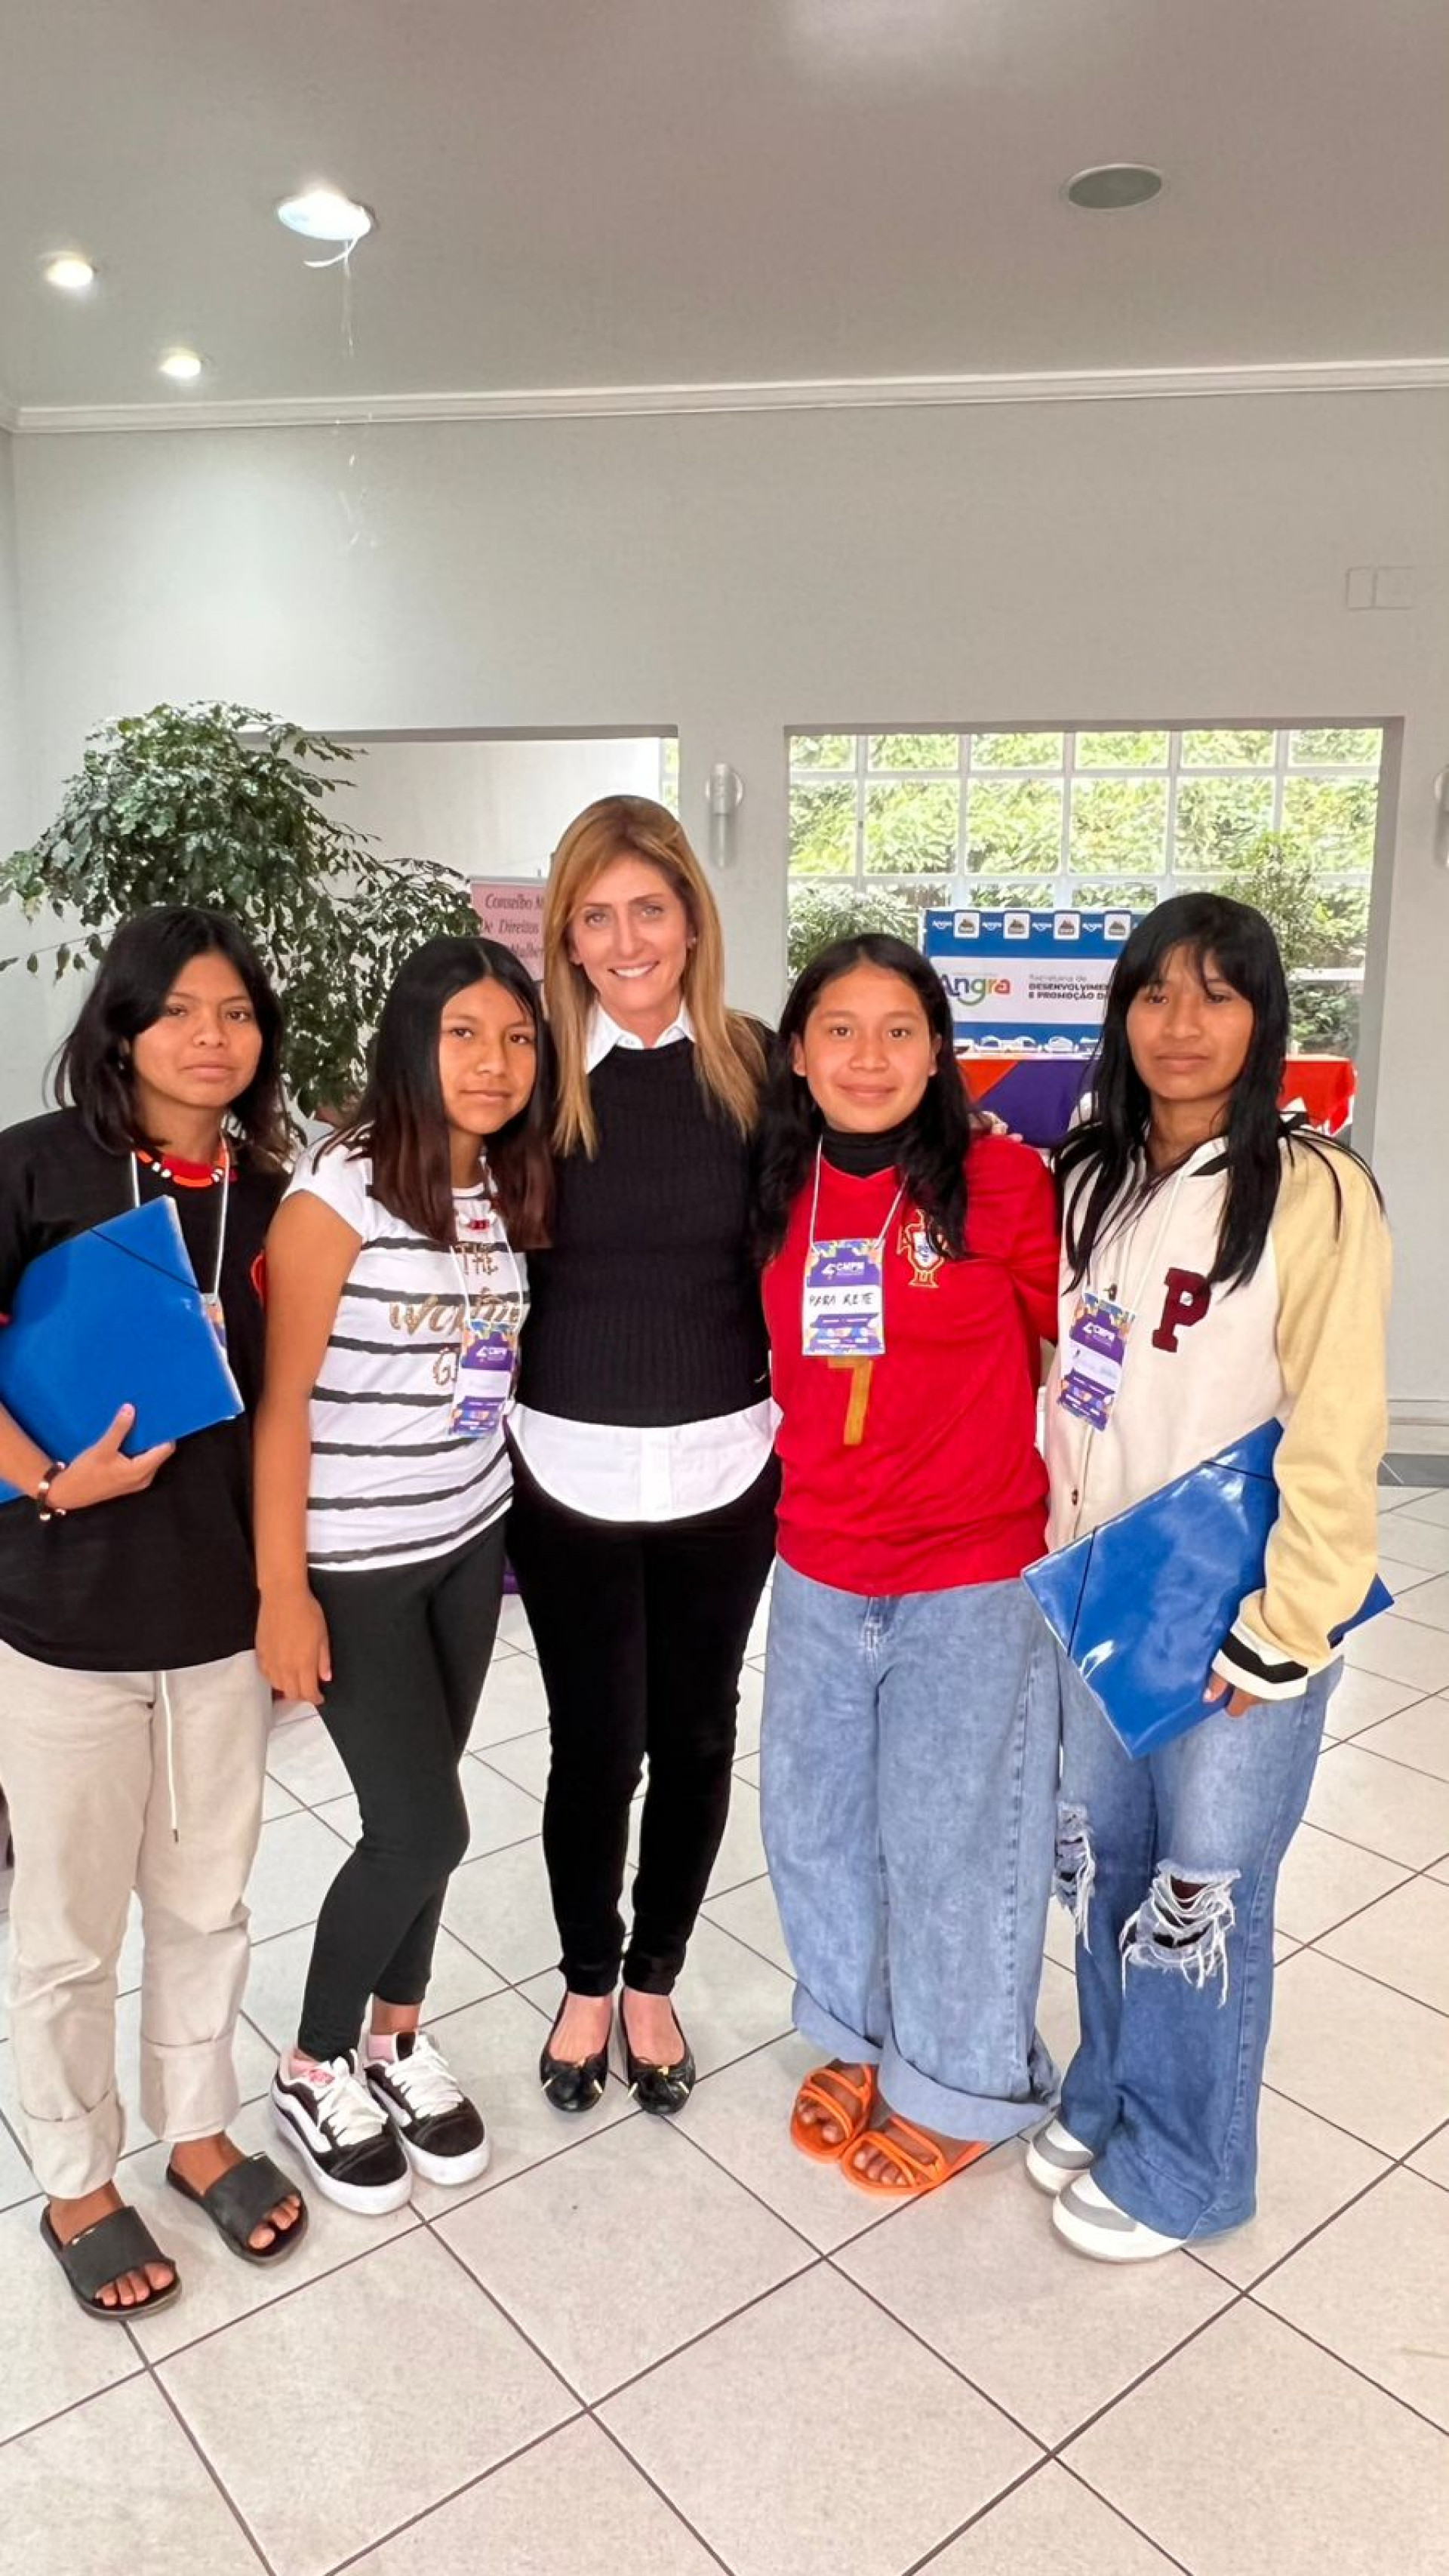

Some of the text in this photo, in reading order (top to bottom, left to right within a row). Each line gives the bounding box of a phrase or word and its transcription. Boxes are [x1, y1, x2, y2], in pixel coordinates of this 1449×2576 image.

[485, 894, 533, 910] Conselho
[498, 919, 539, 934] Direitos
[1029, 974, 1072, 982] Secretaria
[1037, 990, 1094, 1001] PROMOÇÃO
[1152, 1267, 1211, 1353] P
[827, 1356, 873, 1445] 7
